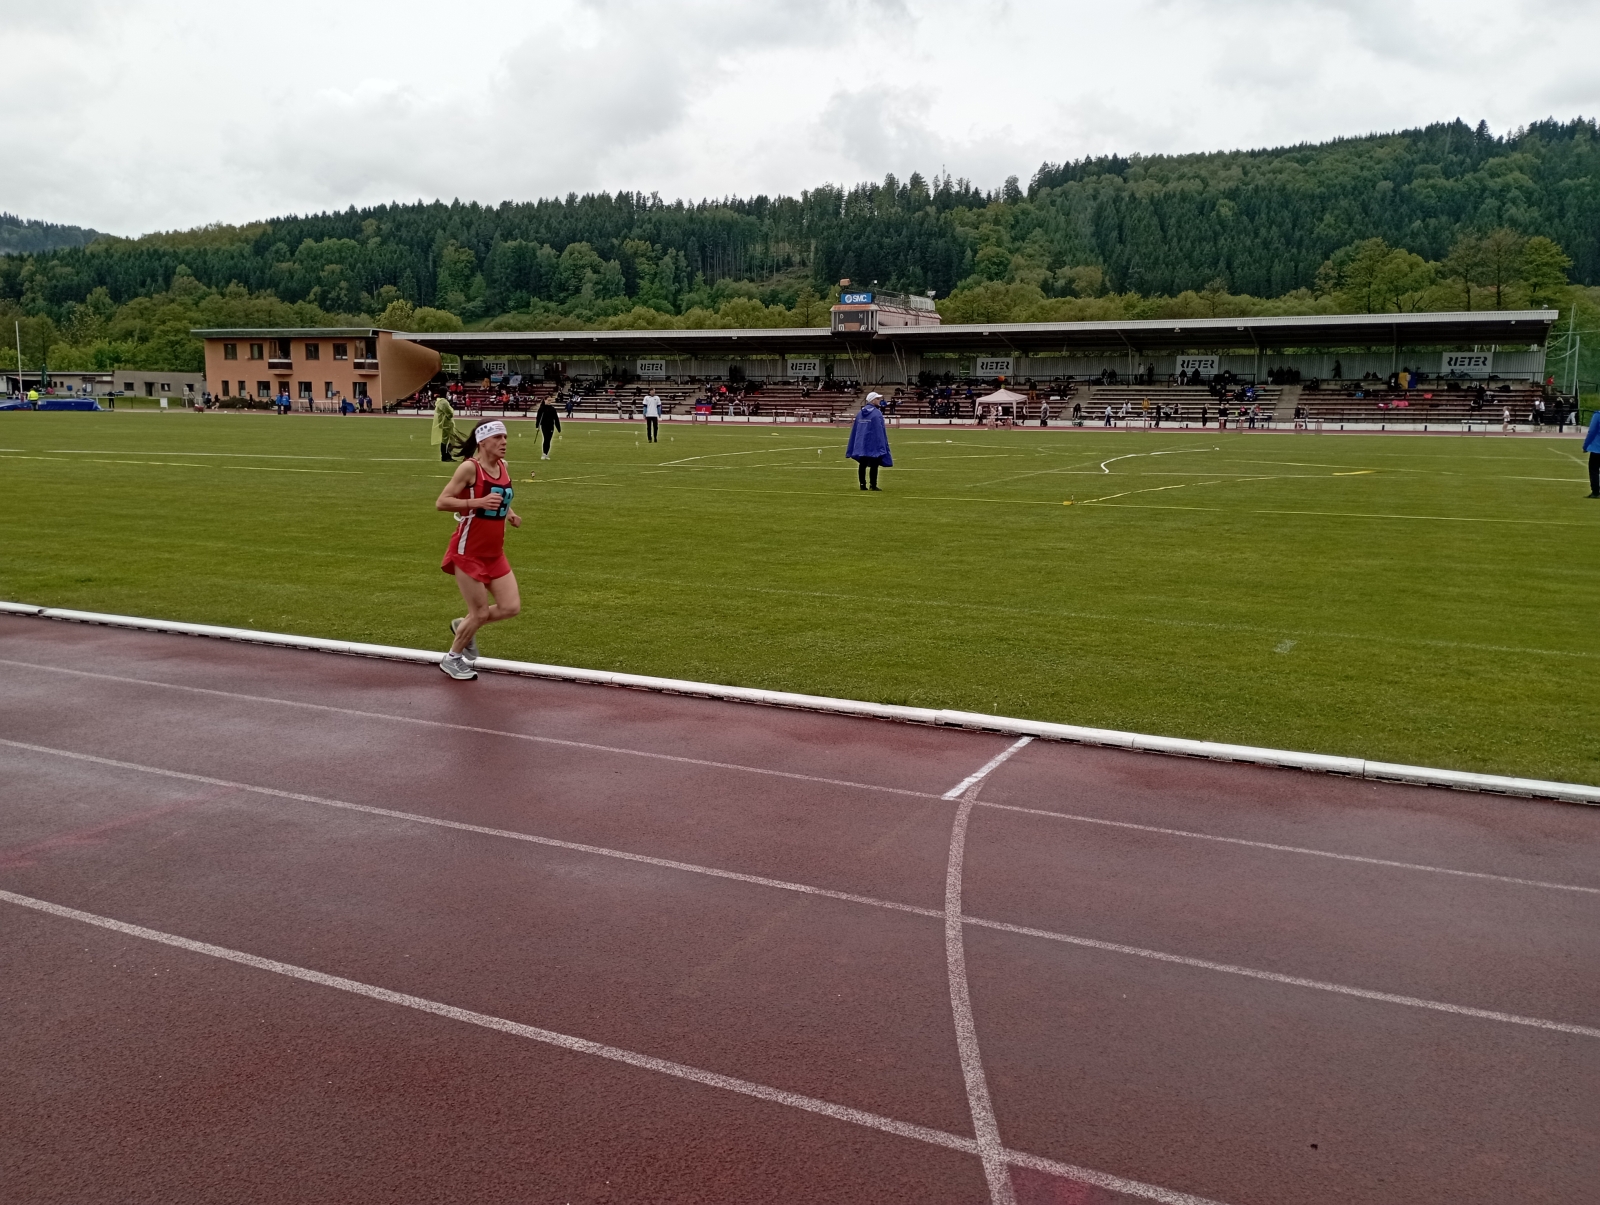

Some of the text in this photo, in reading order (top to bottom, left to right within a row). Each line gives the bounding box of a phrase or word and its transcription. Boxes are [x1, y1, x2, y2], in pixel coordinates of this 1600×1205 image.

[852, 294, 867, 303] SMC
[981, 361, 1010, 370] RIETER
[1181, 360, 1214, 369] RIETER
[1447, 356, 1488, 367] RIETER
[640, 363, 662, 371] RIETER
[791, 363, 816, 371] RIETER
